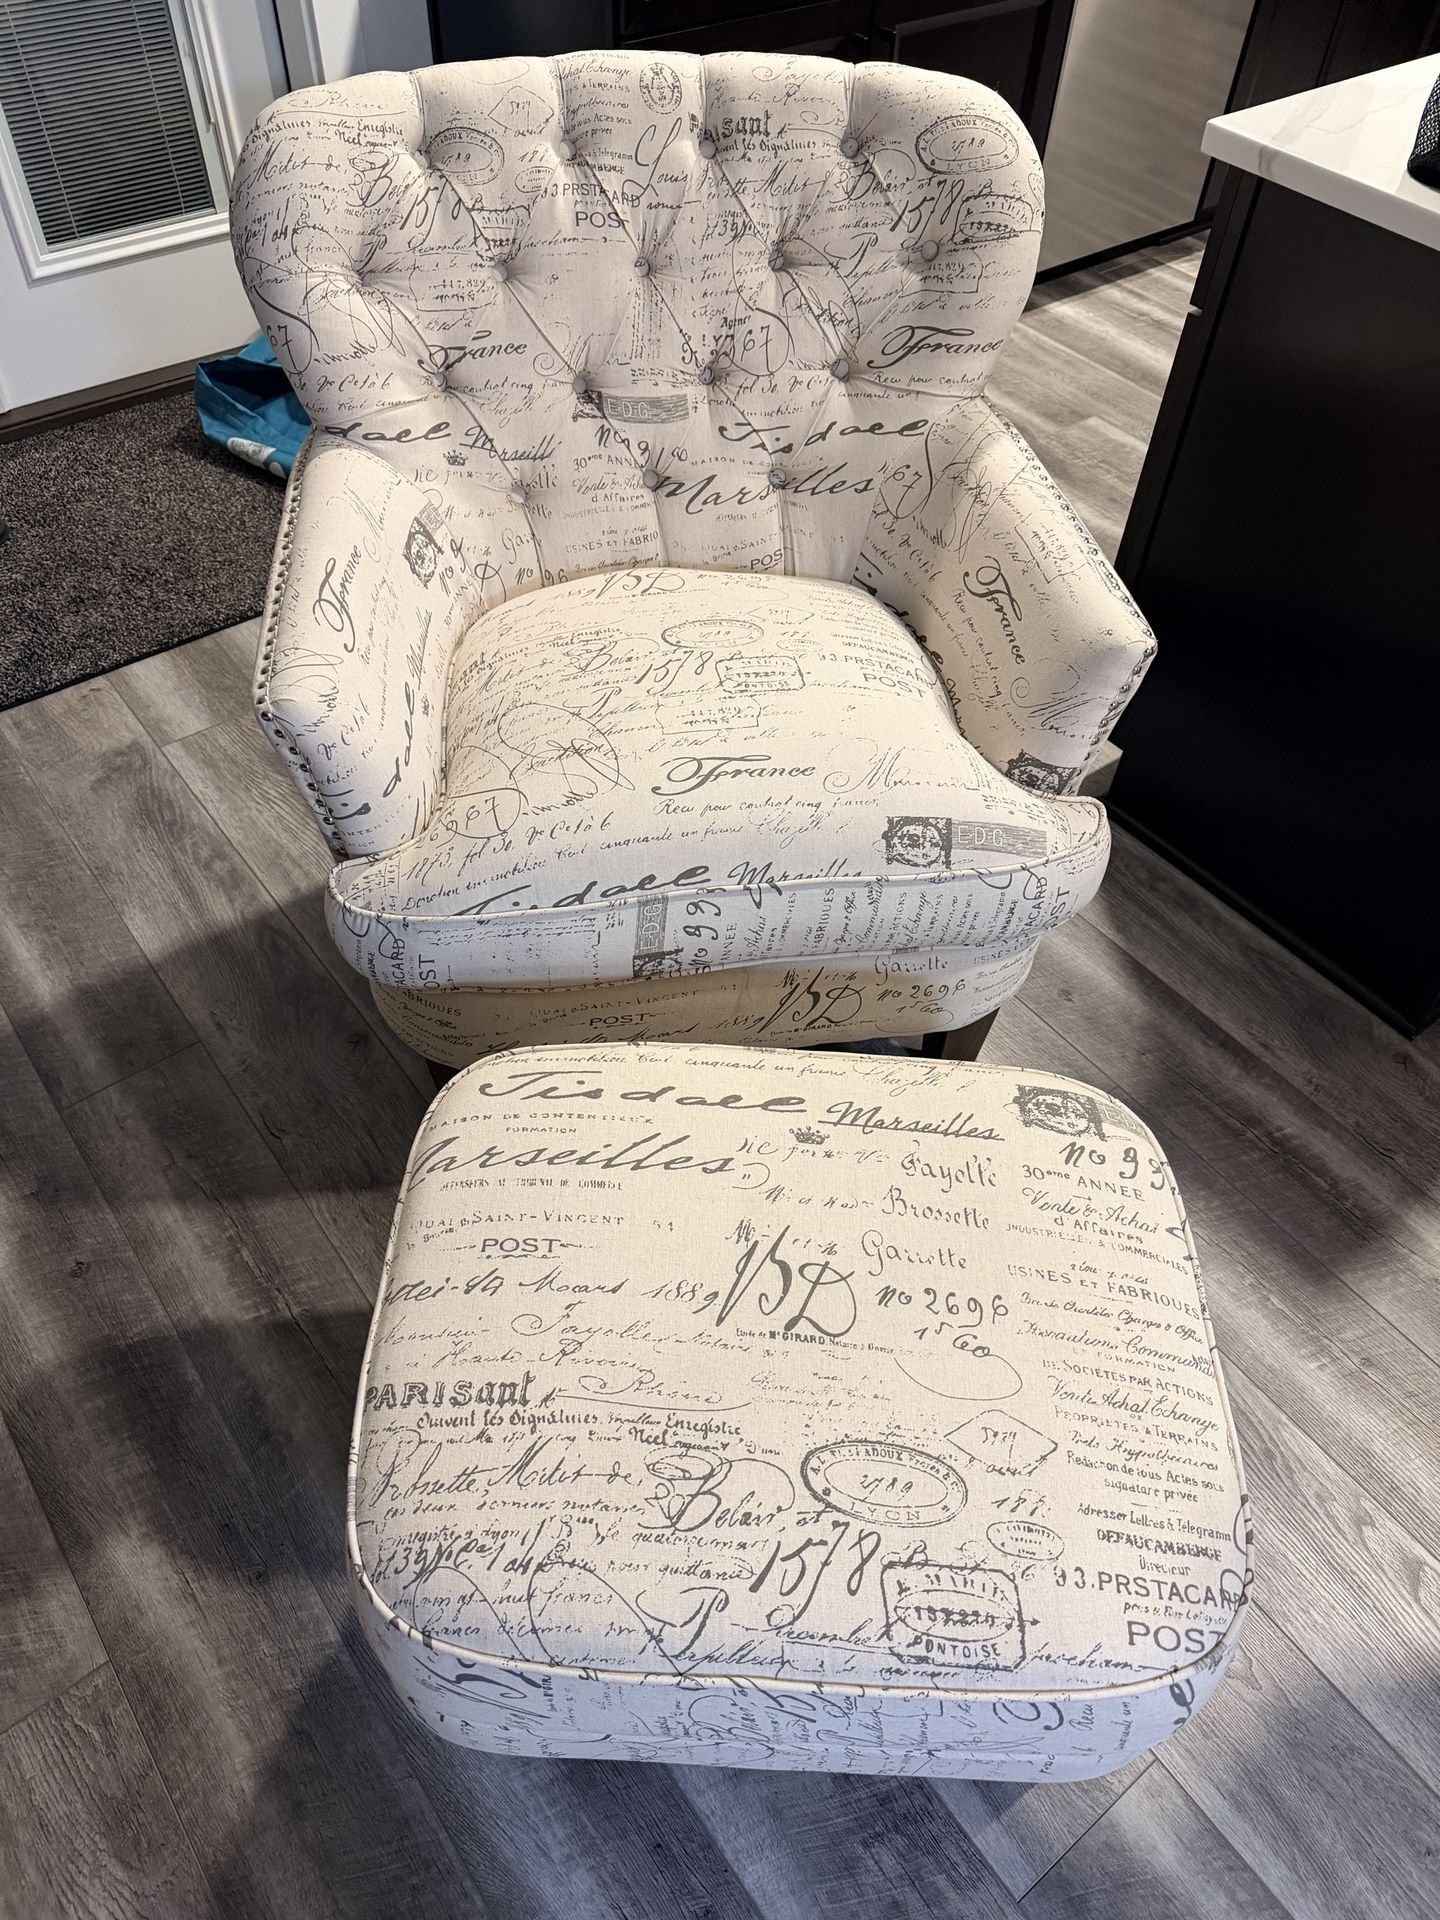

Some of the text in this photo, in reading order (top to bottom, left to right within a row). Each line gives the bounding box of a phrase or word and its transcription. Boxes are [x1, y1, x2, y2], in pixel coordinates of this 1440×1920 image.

[863, 672, 926, 697] POST
[589, 1013, 651, 1027] POST
[481, 1238, 561, 1254] POST
